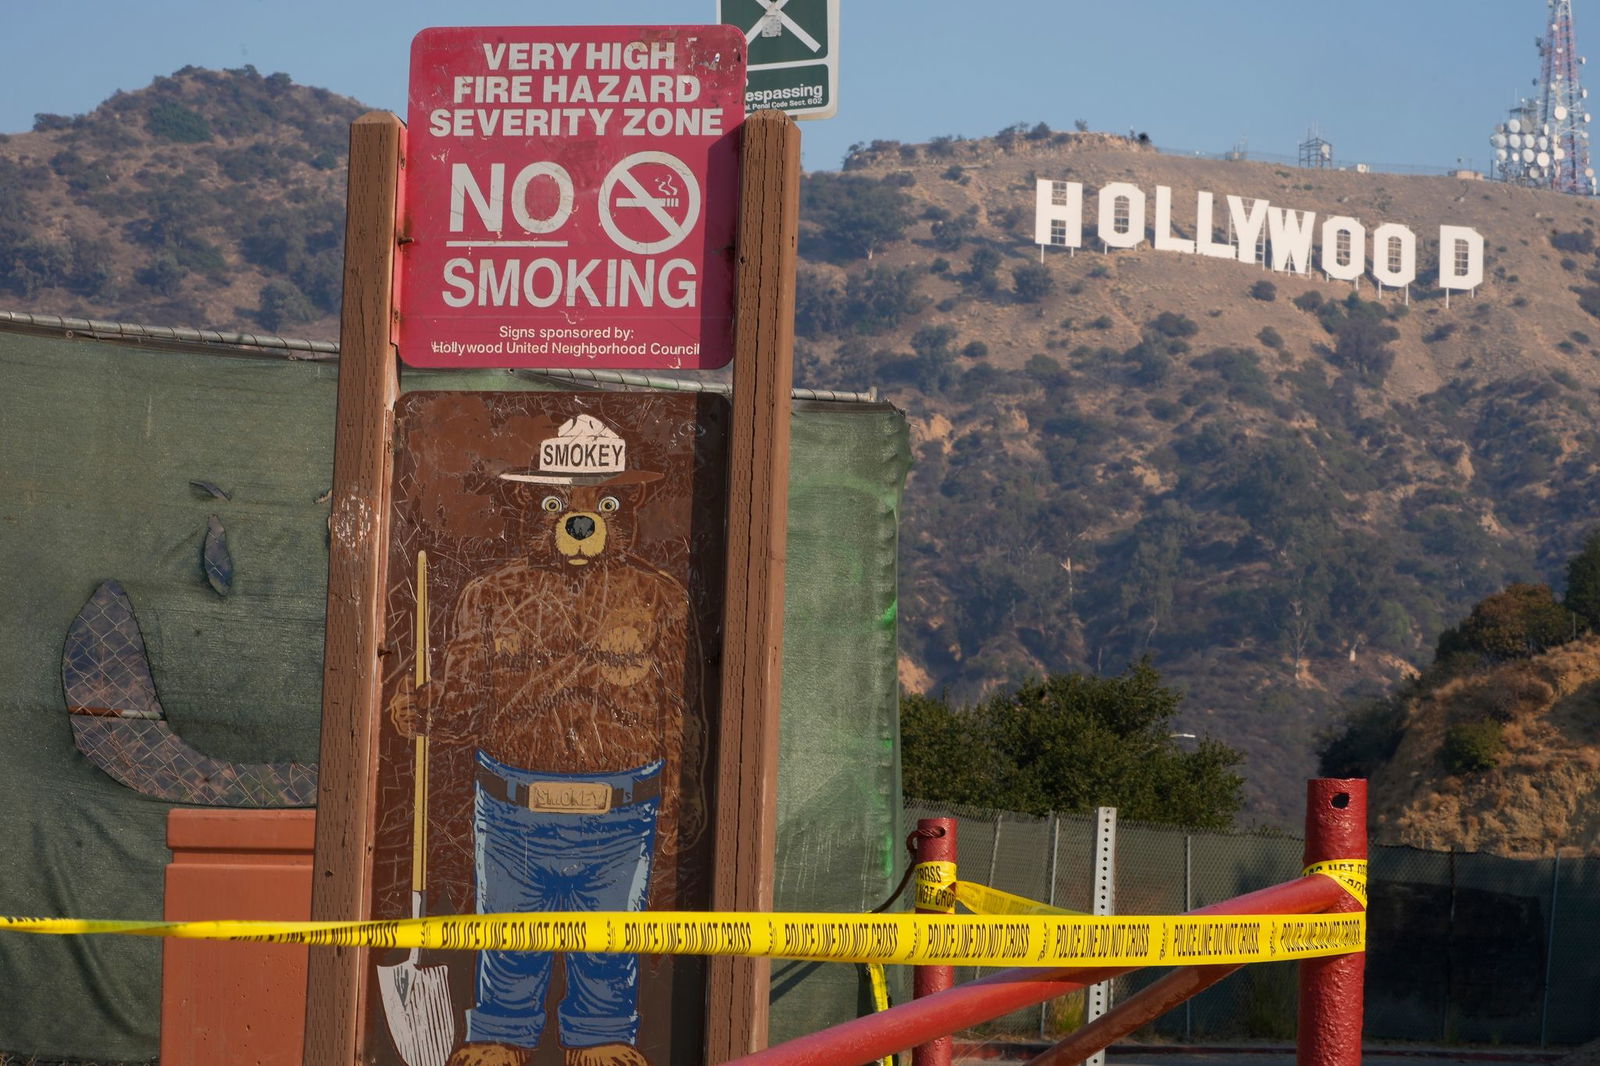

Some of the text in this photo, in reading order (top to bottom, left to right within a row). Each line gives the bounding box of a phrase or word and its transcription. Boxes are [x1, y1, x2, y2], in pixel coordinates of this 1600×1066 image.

[483, 42, 675, 70] VERY HIGH
[454, 75, 701, 103] FIRE HAZARD
[771, 100, 788, 109] Code
[430, 107, 723, 137] SEVERITY ZONE
[448, 161, 575, 234] NO
[1035, 178, 1484, 289] HOLLYWOOD
[442, 258, 697, 308] SMOKING
[499, 326, 635, 341] Signs sponsored by:
[432, 341, 700, 357] Hollywood United Neighborhood Council
[543, 443, 624, 467] SMOKEY
[357, 922, 399, 948] CROSS
[441, 921, 481, 950] POLICE
[482, 921, 507, 950] LINE
[509, 921, 525, 950] DO
[528, 921, 550, 950] NOT
[552, 921, 587, 950] CROSS
[623, 922, 658, 952] POLICE
[659, 922, 682, 952] LINE
[683, 922, 699, 952] DO
[700, 922, 718, 953] NOT
[719, 922, 751, 953] CROSS
[782, 923, 815, 957] POLICE
[815, 923, 836, 957] LINE
[833, 923, 851, 957] DO
[849, 923, 869, 957] NOT
[867, 923, 898, 958] CROSS
[922, 923, 955, 959] POLICE
[954, 924, 973, 958] LINE
[972, 923, 987, 958] DO
[985, 924, 1004, 958] NOT
[1002, 923, 1030, 958] CROSS
[1053, 924, 1081, 958] POLICE
[1080, 924, 1098, 957] LINE
[1098, 924, 1109, 957] DO
[1110, 924, 1125, 957] NOT
[1125, 924, 1150, 957] CROSS
[1173, 923, 1197, 957] POLICE
[1198, 923, 1213, 956] LINE
[1213, 923, 1223, 955] DO
[1224, 923, 1238, 955] NOT
[1238, 922, 1260, 954] CROSS
